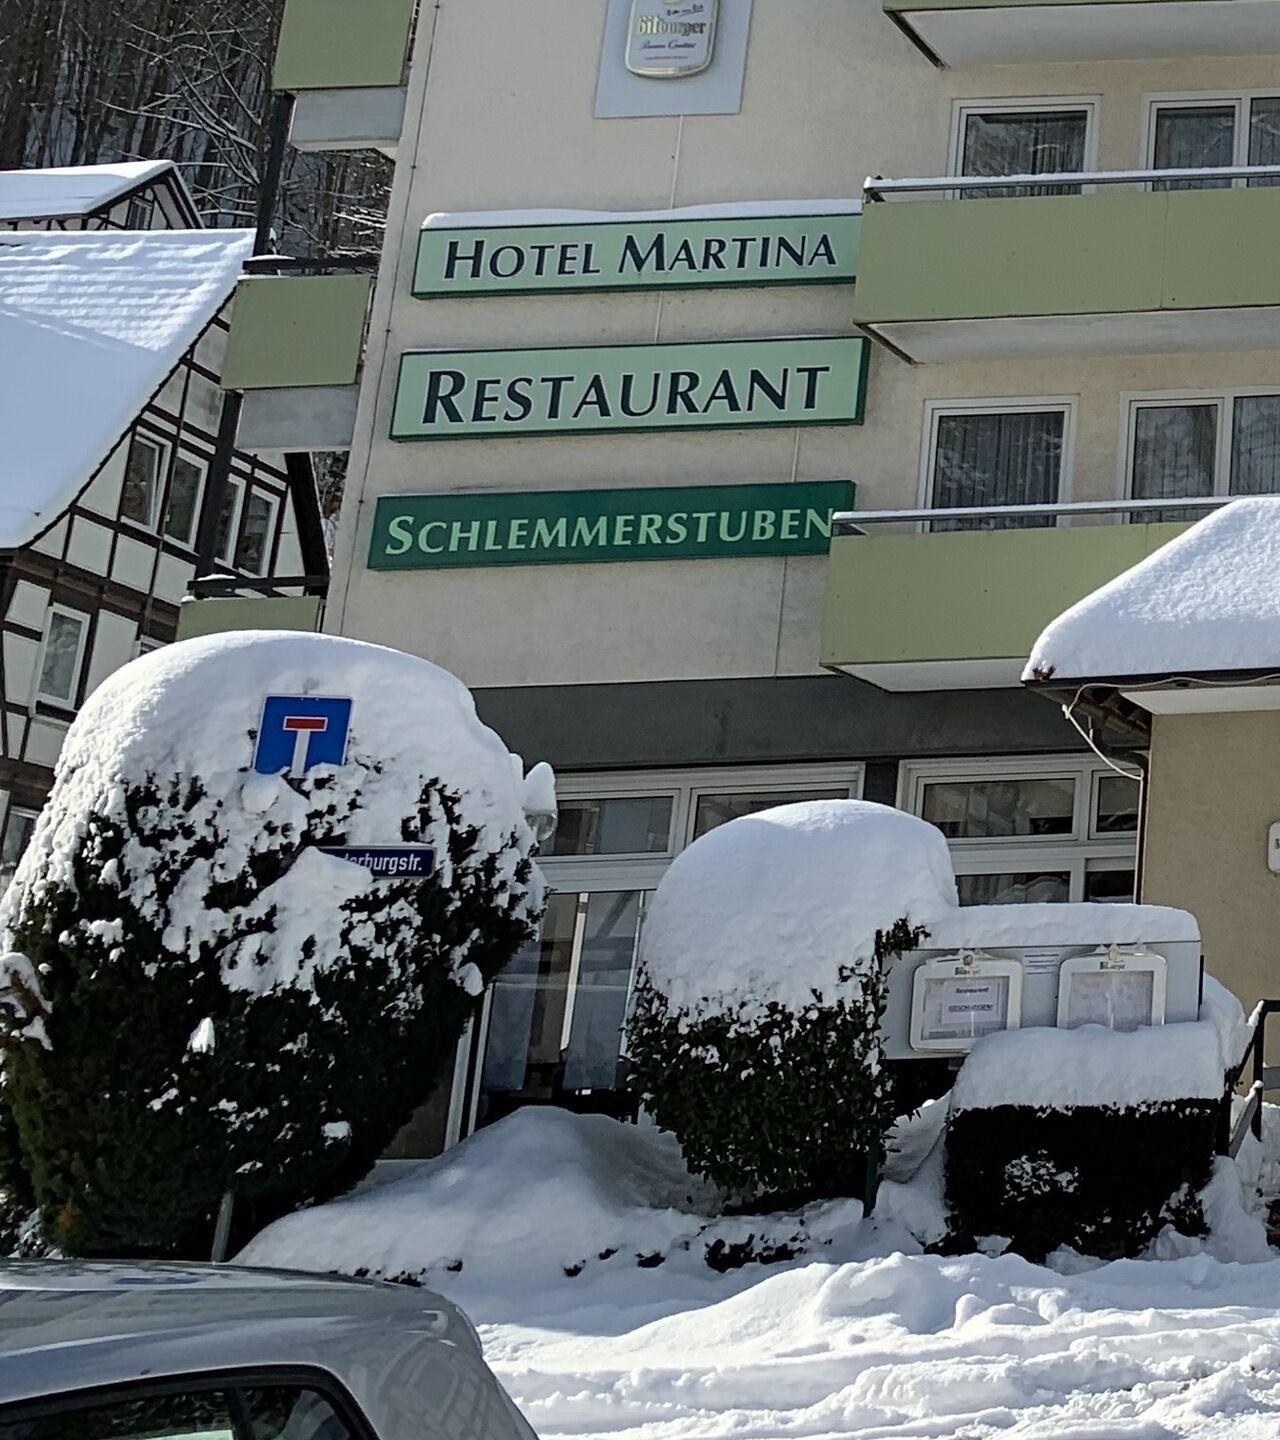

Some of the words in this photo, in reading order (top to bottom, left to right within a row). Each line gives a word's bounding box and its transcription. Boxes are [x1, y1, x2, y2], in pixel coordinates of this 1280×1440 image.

[443, 239, 601, 280] HOTEL
[617, 232, 838, 275] MARTINA
[420, 364, 832, 425] RESTAURANT
[384, 507, 834, 555] SCHLEMMERSTUBEN
